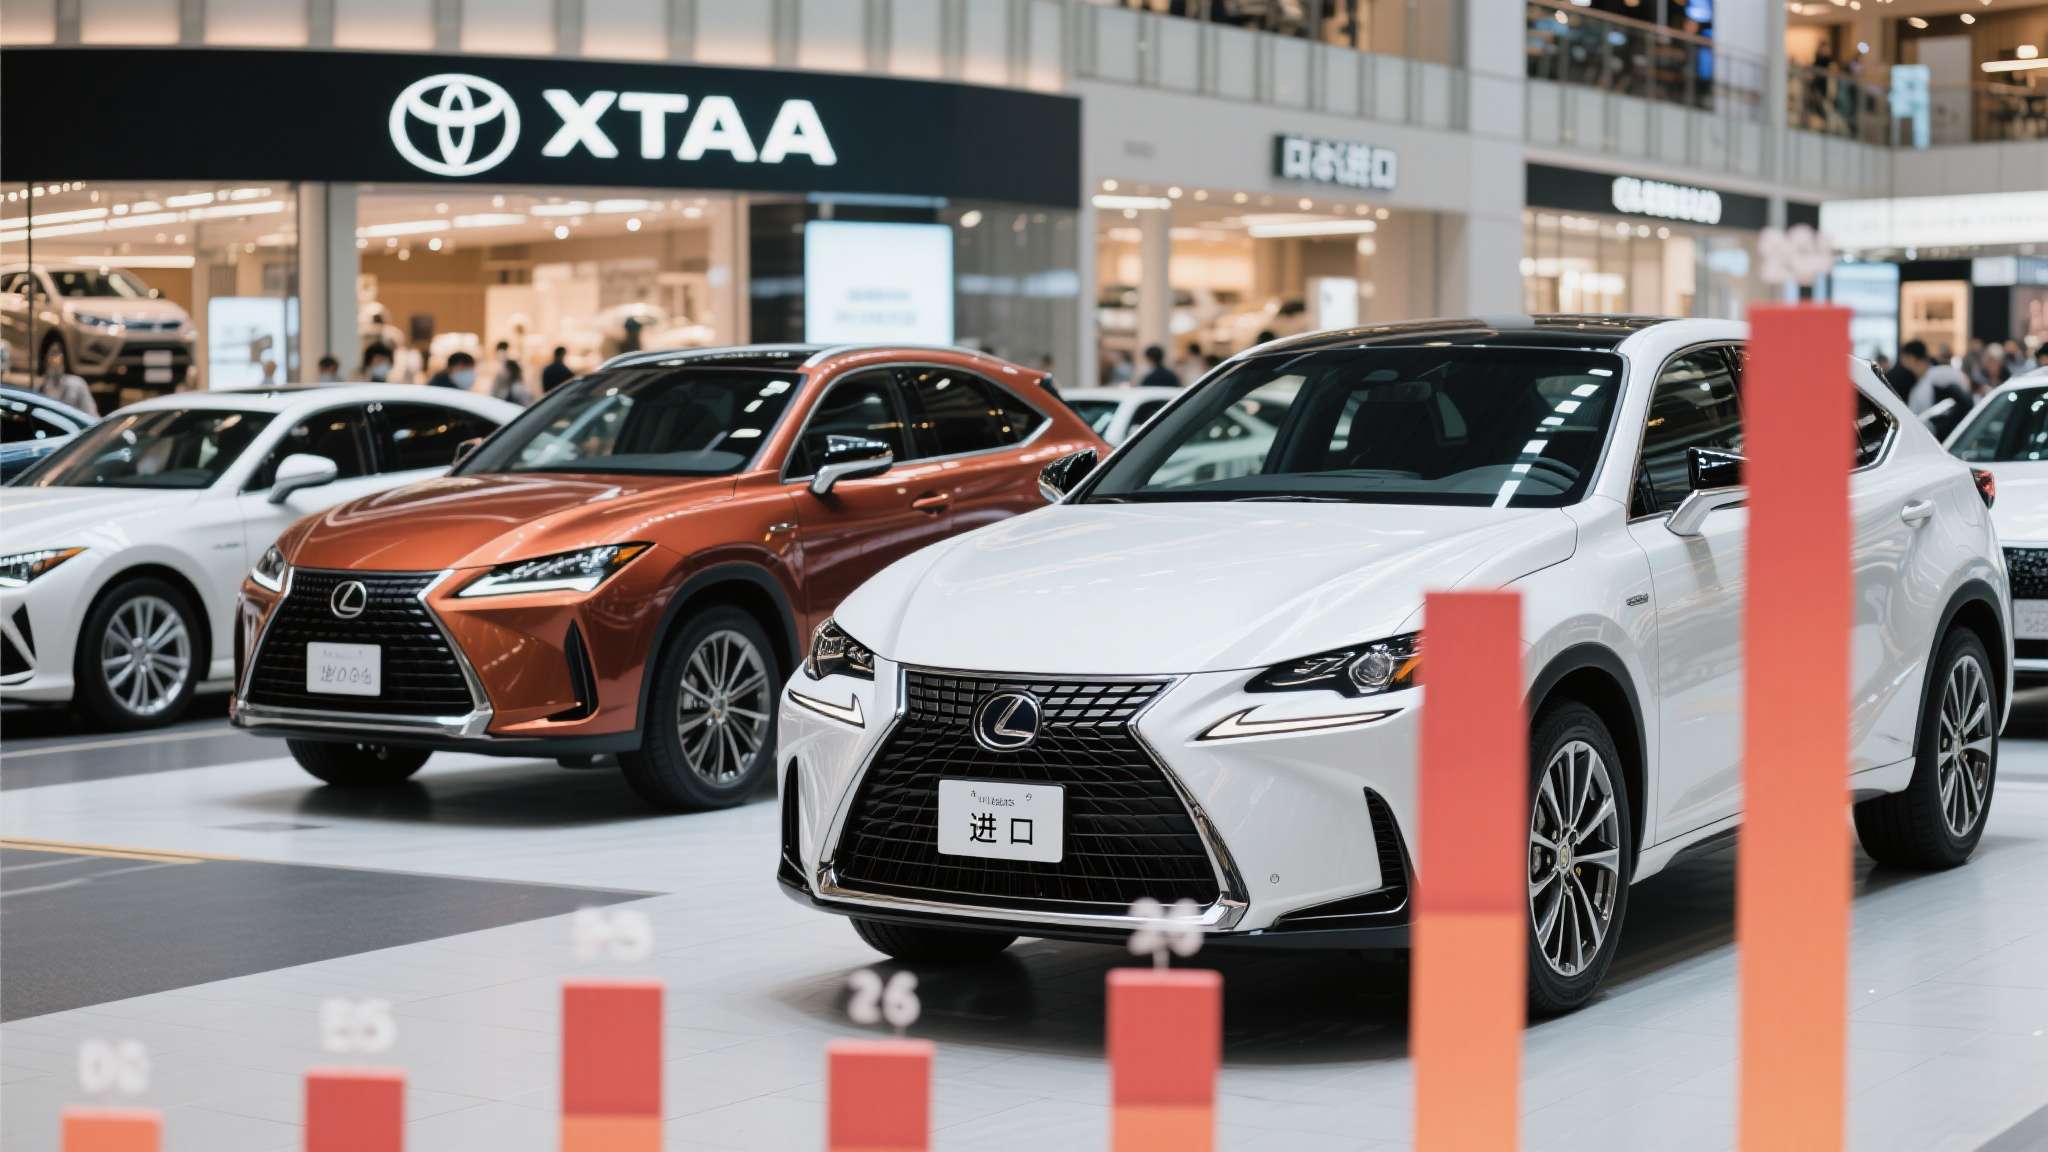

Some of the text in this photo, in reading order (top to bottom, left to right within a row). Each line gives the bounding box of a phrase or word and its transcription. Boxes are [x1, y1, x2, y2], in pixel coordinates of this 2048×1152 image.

[541, 88, 838, 166] XTAA
[969, 812, 1033, 845] 进口
[846, 969, 921, 1027] 26
